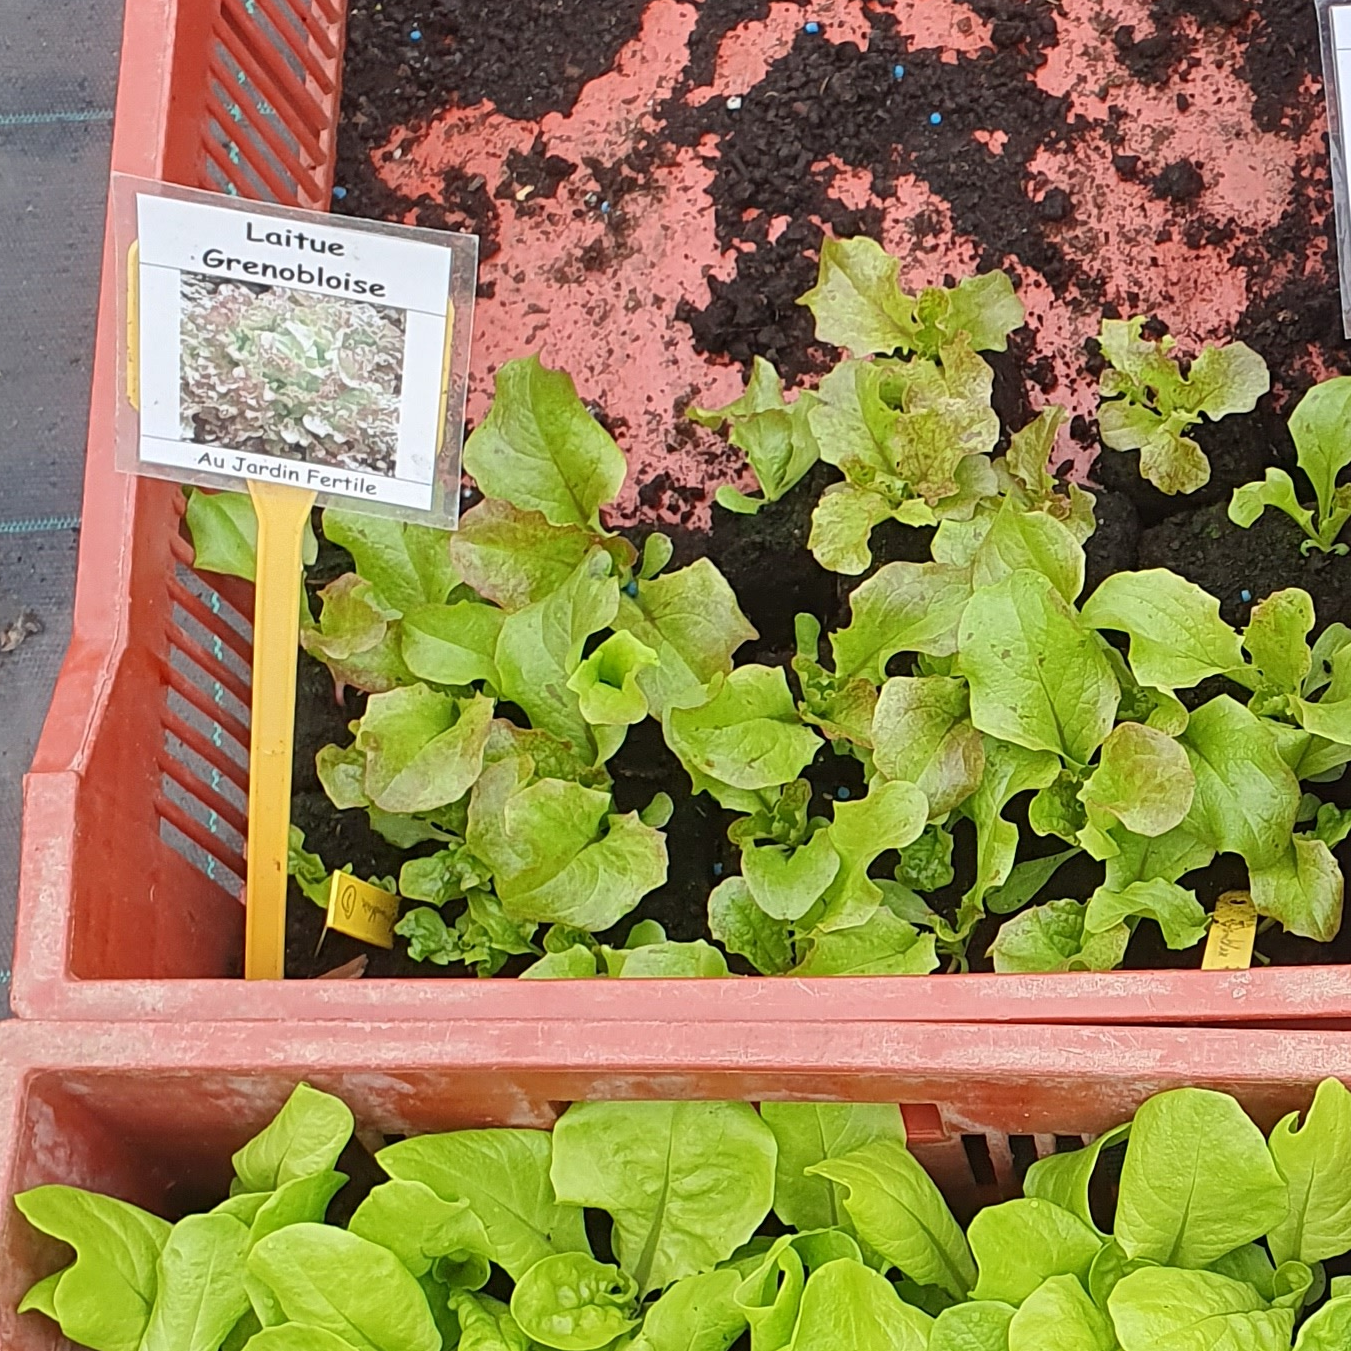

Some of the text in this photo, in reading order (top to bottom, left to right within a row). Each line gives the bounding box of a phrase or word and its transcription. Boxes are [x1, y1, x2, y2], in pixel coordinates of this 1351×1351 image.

[246, 222, 346, 257] Laitue
[202, 248, 387, 298] Grenobloise
[198, 452, 378, 495] Au Jardin Fertile
